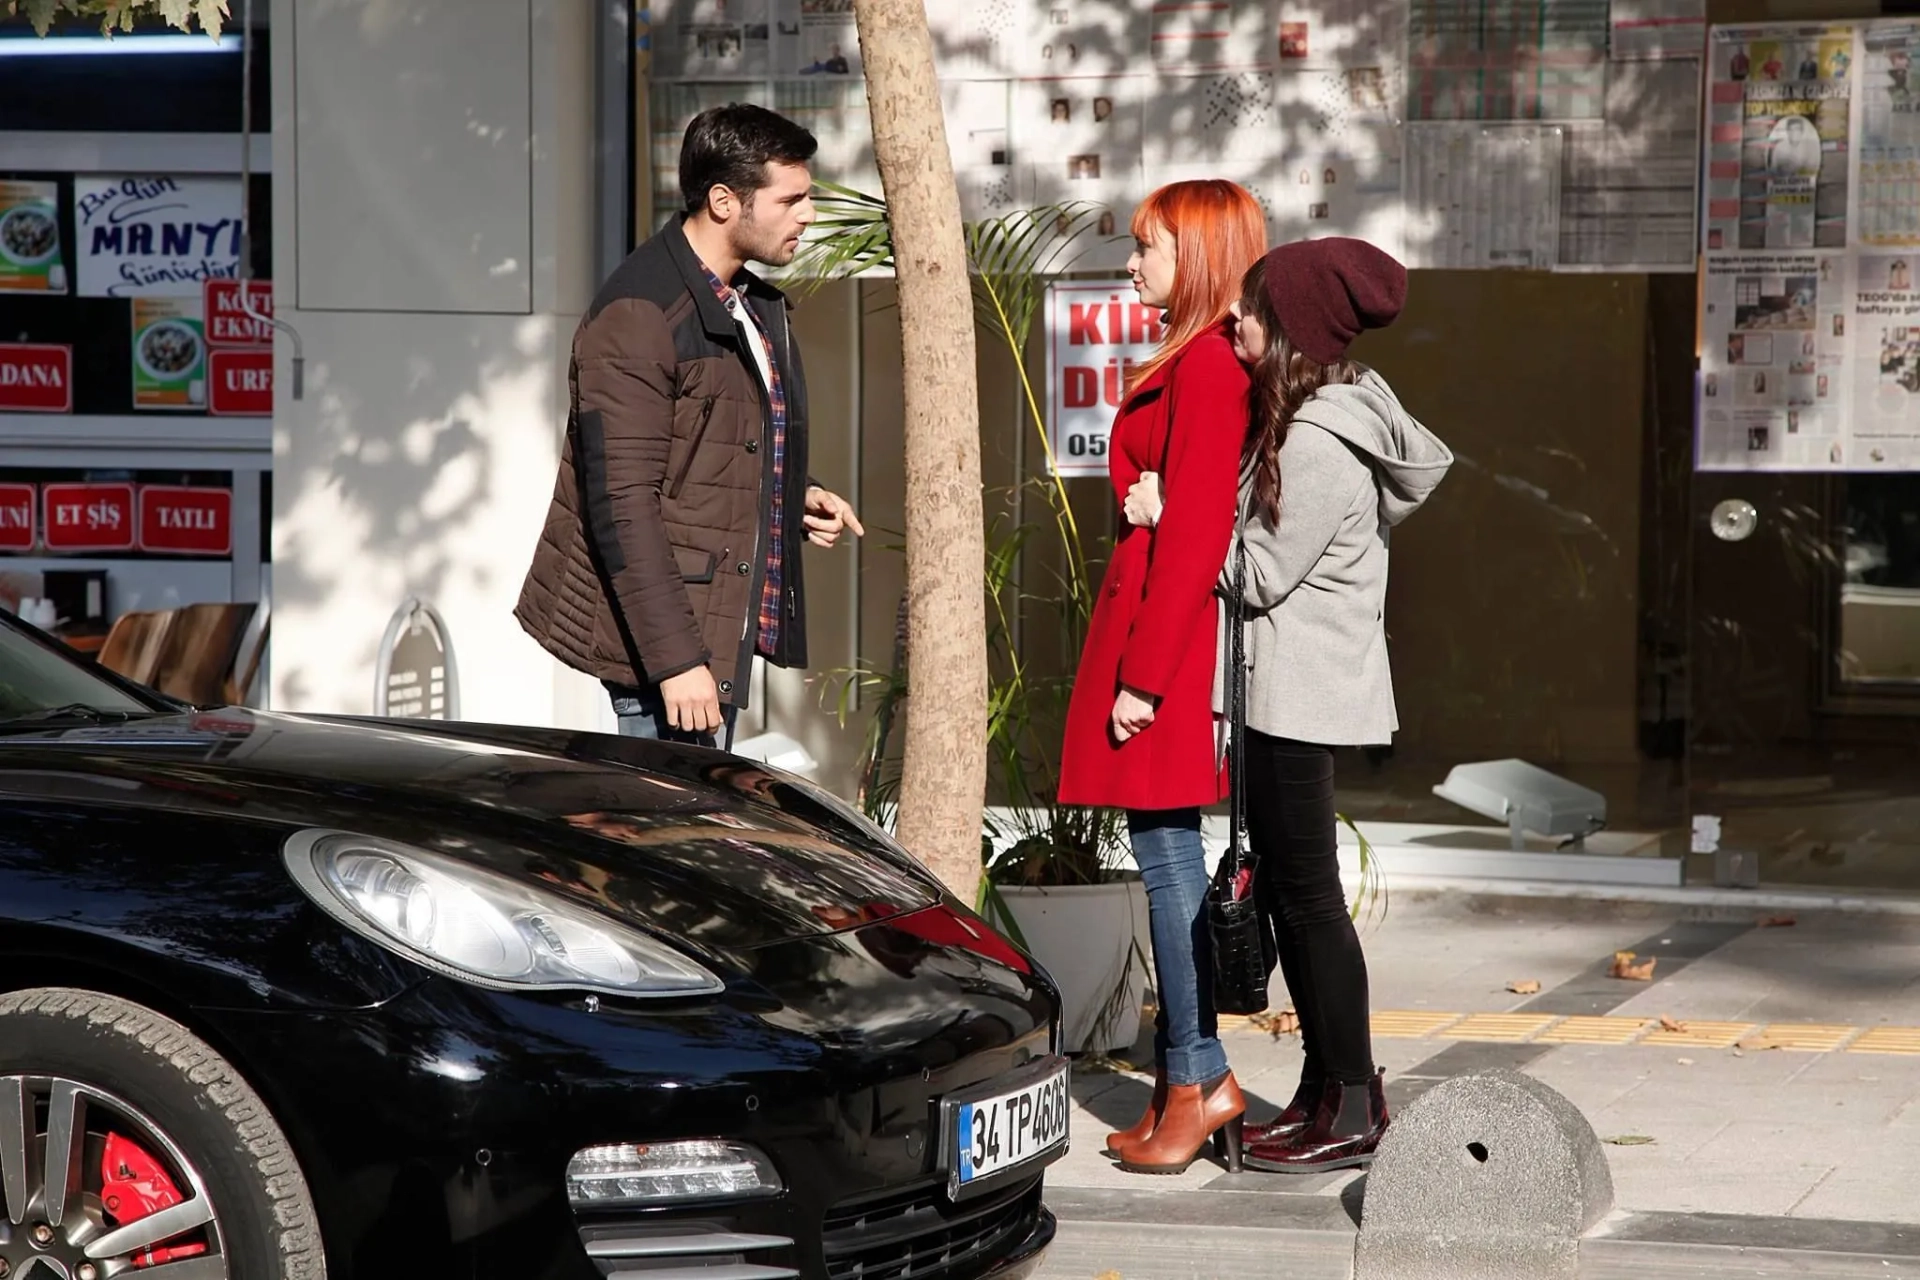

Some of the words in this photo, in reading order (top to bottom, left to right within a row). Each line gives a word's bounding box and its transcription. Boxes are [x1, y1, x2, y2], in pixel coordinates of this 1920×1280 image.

[1069, 295, 1162, 346] KİR
[0, 363, 62, 387] DANA
[226, 367, 273, 391] URF
[1068, 433, 1110, 457] 05
[56, 504, 82, 525] ET
[87, 499, 120, 530] ŞİŞ
[156, 506, 215, 530] TATLI
[972, 1103, 1000, 1170] 34
[1006, 1092, 1032, 1158] TP
[1032, 1075, 1065, 1146] 4606
[960, 1148, 971, 1167] TR
